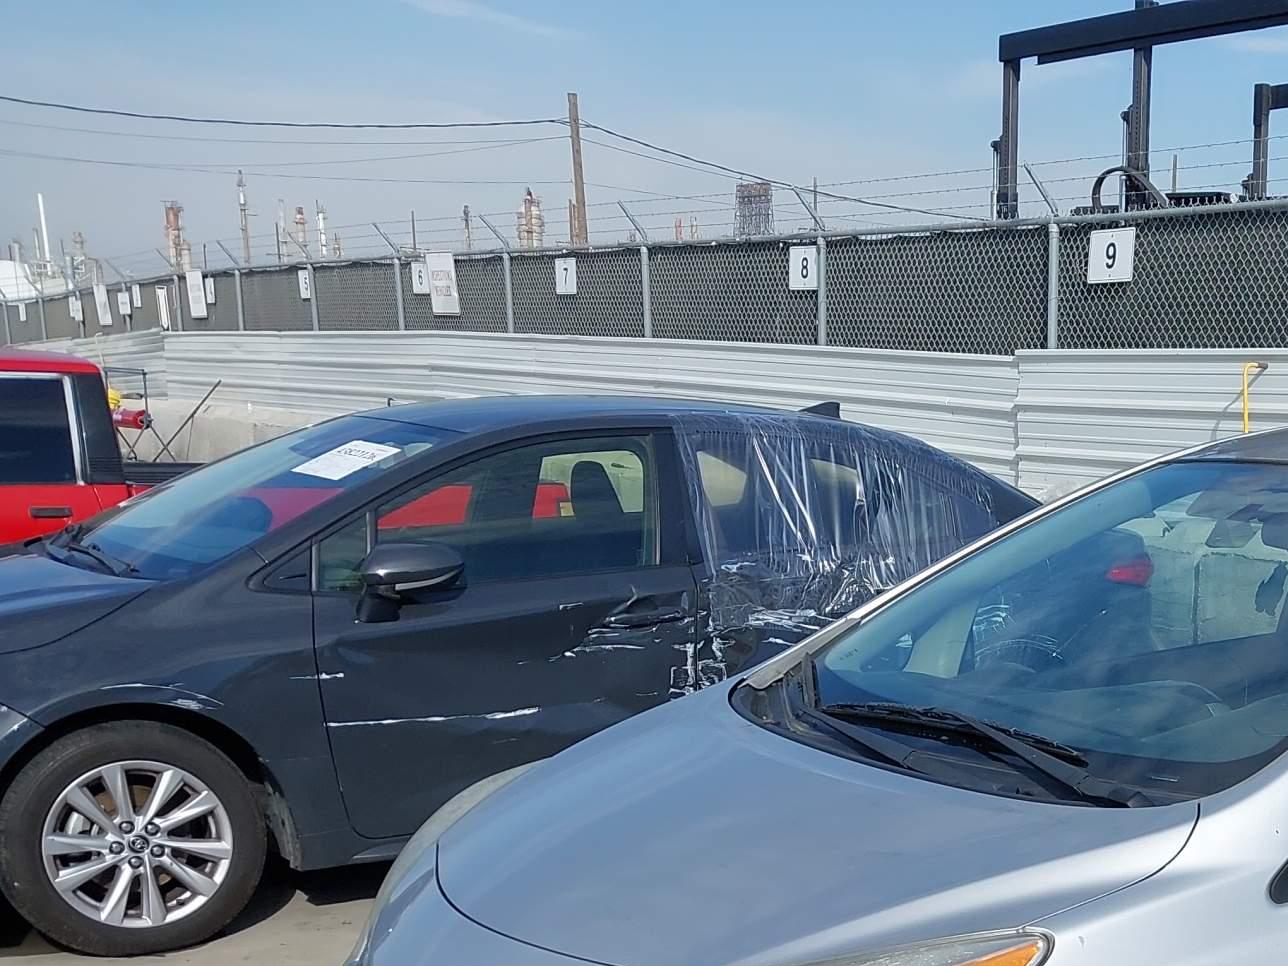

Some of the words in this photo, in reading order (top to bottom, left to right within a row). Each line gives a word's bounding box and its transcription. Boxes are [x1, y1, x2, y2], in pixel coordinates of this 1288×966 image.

[800, 256, 809, 279] 8
[1104, 242, 1118, 270] 9
[303, 276, 309, 291] 5
[417, 269, 424, 286] 6
[562, 267, 569, 290] 7
